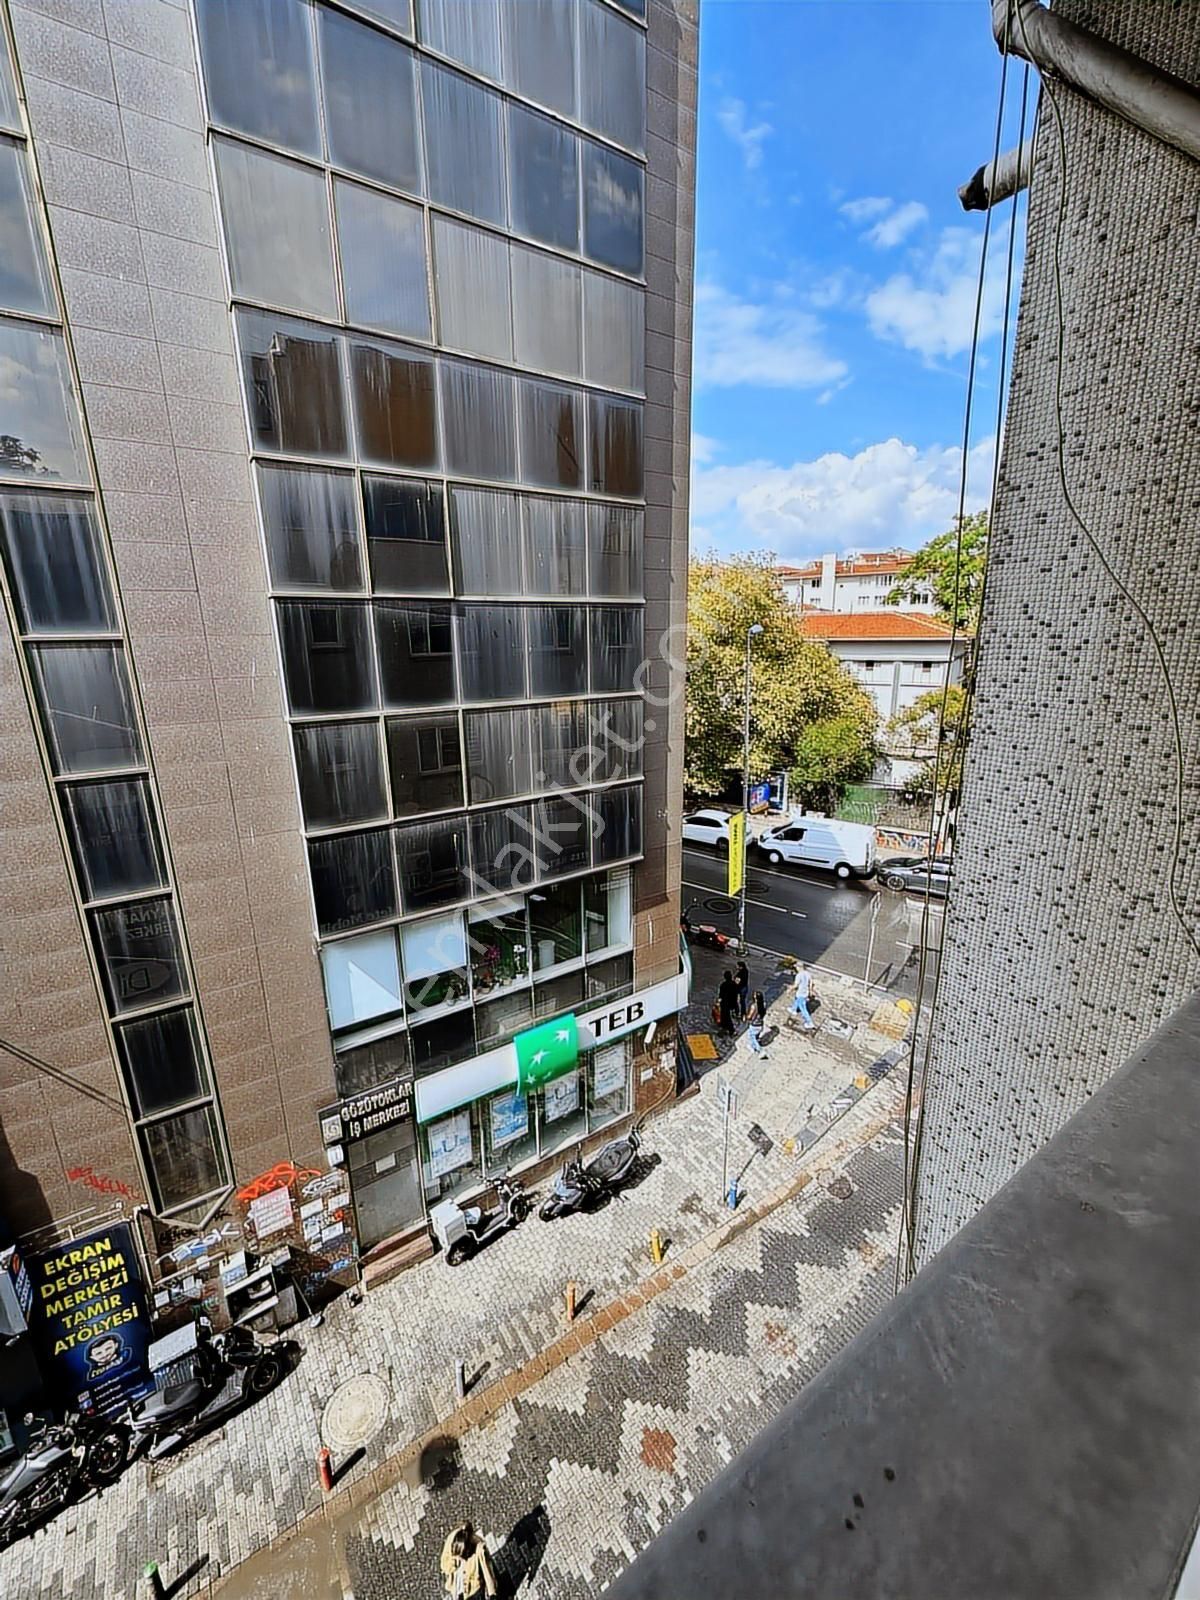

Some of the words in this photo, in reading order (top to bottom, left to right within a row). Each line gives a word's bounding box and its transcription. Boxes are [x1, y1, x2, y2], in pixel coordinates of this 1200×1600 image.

[589, 1002, 644, 1037] TEB
[363, 1099, 410, 1131] MERKEZİ
[44, 1238, 112, 1275] EKRAN
[41, 1255, 125, 1298] DEĞİŞİM
[46, 1268, 129, 1317] MERKEZİ
[54, 1303, 139, 1355] ATÖLYESİ
[62, 1294, 121, 1329] TAMİR
